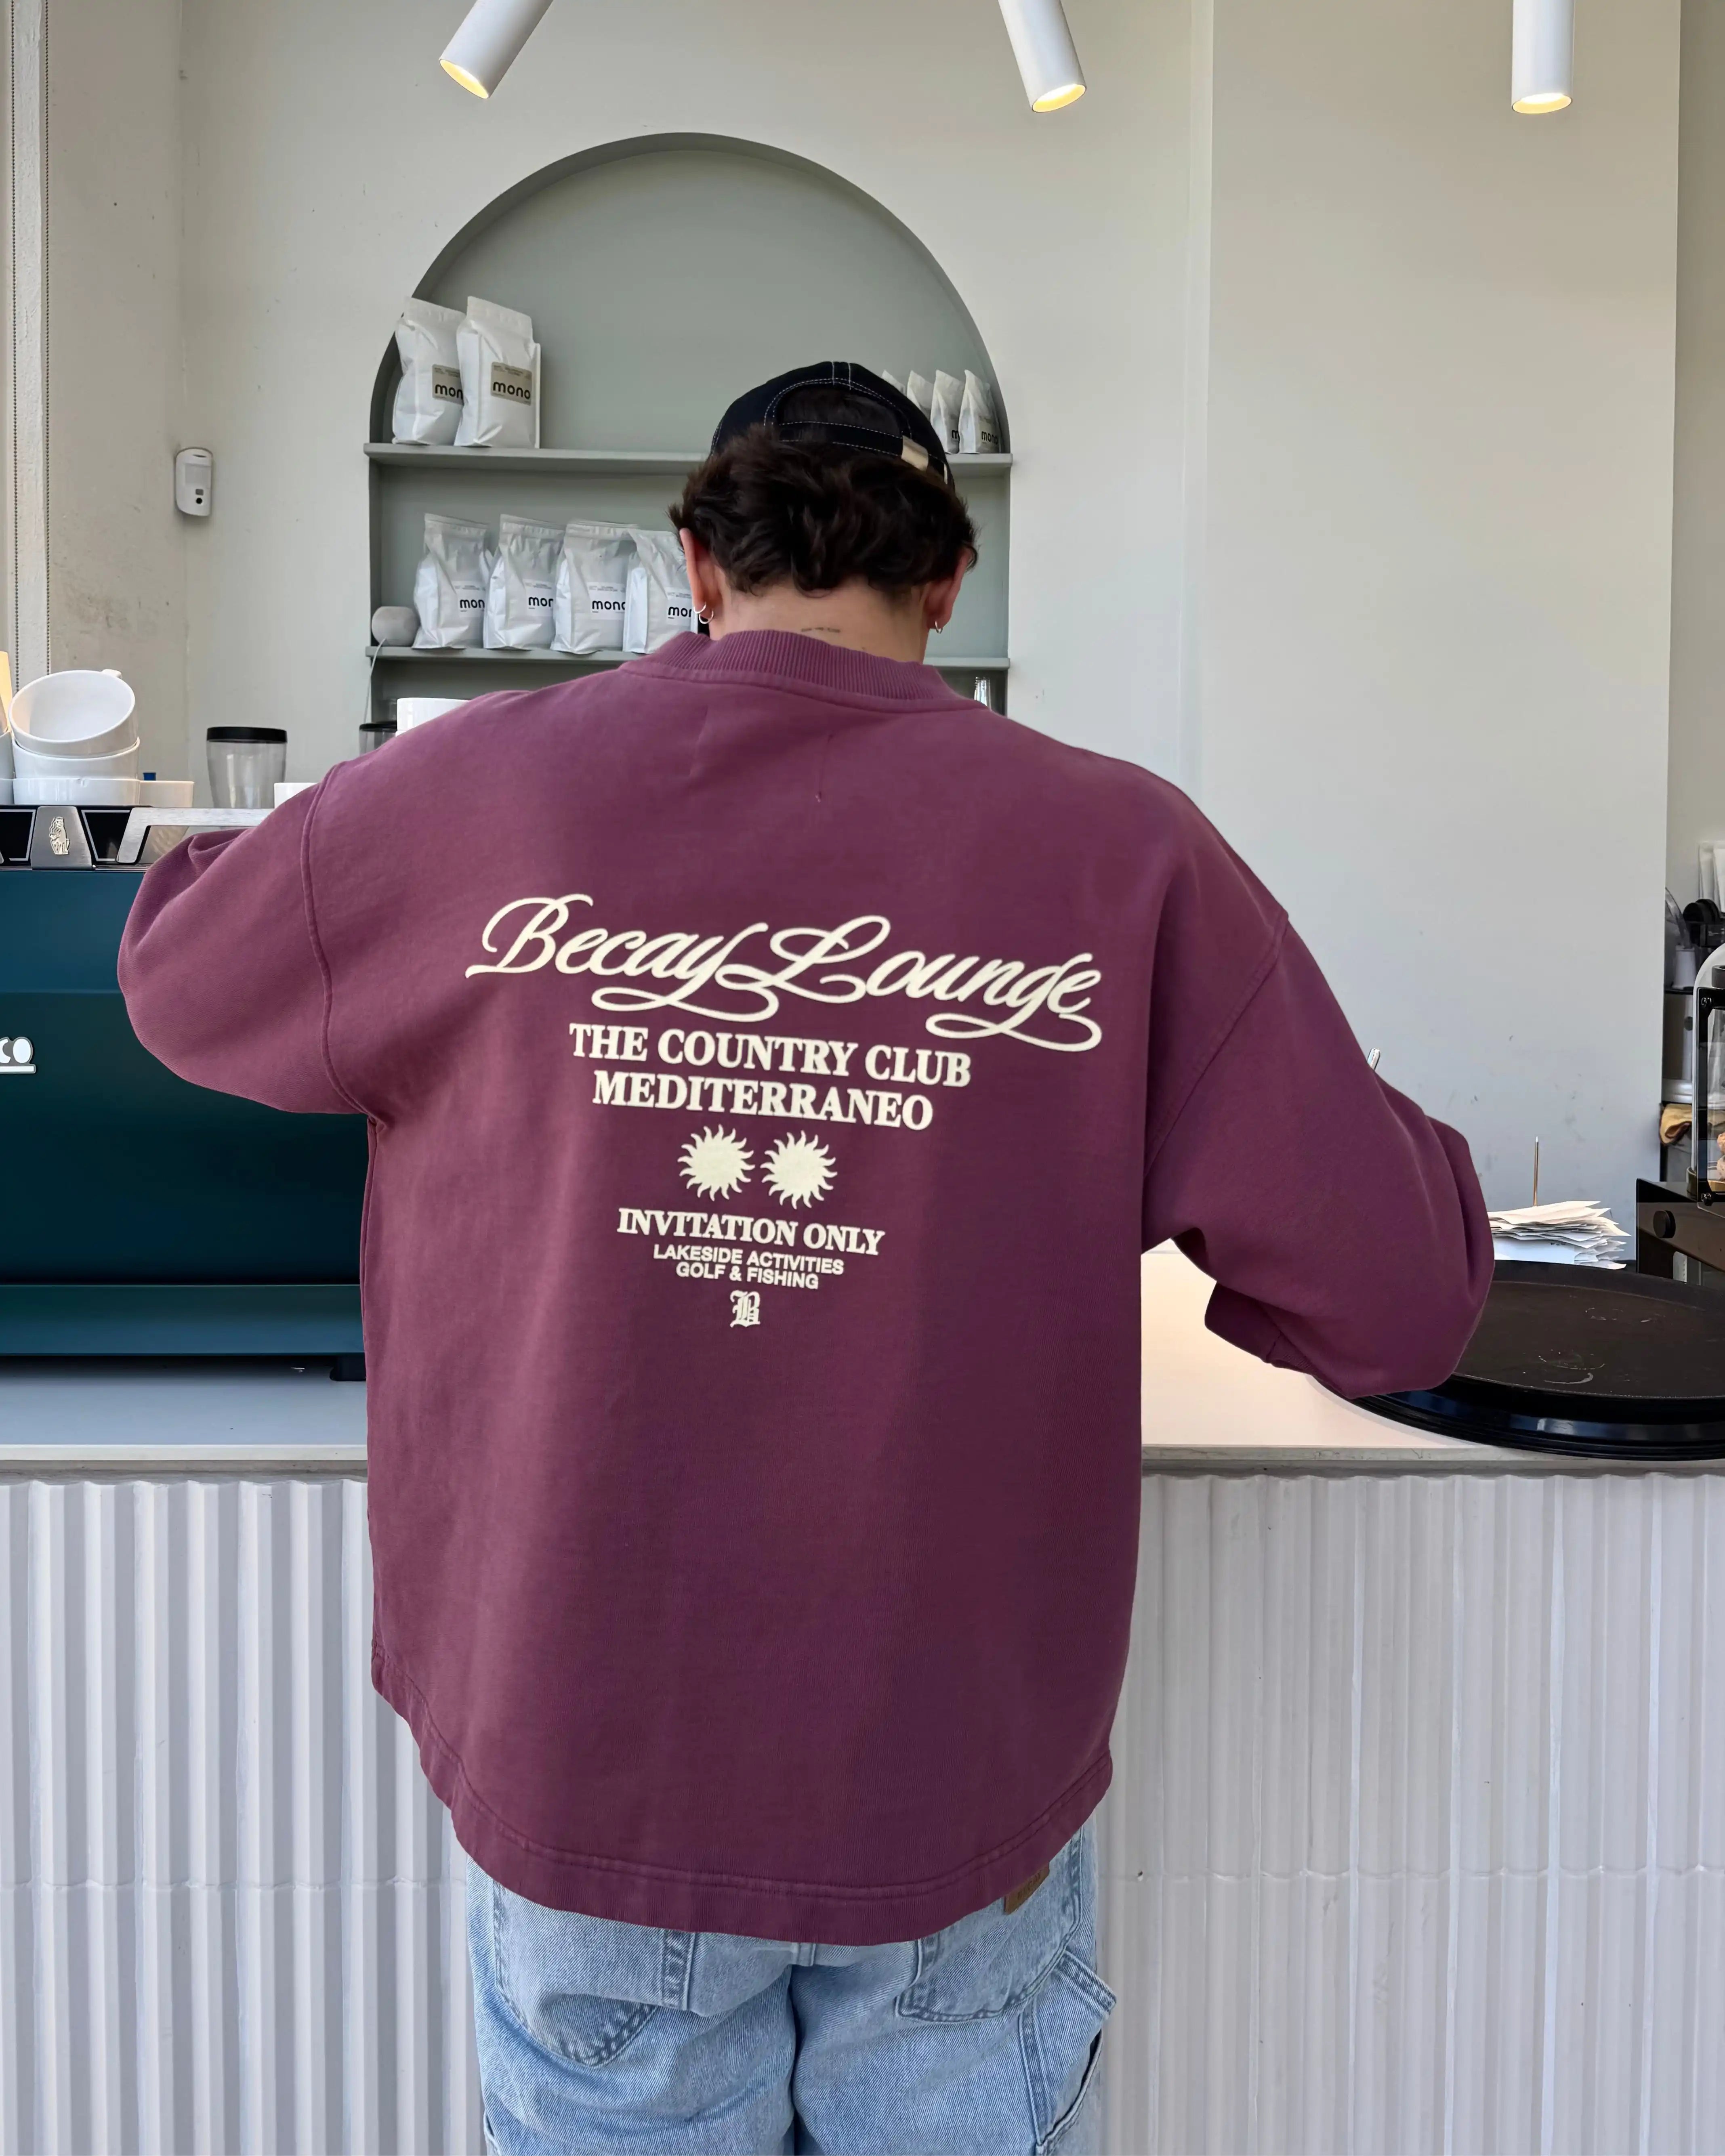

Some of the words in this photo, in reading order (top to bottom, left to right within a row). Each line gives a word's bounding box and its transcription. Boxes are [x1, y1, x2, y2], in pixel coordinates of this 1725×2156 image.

[435, 384, 463, 399] mon
[493, 382, 531, 399] mono
[460, 599, 485, 608] mon
[465, 894, 779, 1022] Becay
[714, 915, 1102, 1052] Lounge
[569, 1022, 649, 1062] THE
[658, 1029, 859, 1076] COUNTRY
[865, 1045, 971, 1087] CLUB
[592, 1070, 933, 1130] MEDITERRANEO
[617, 1208, 798, 1247] INVITATION
[803, 1223, 885, 1255] ONLY
[653, 1244, 743, 1265] LAKESIDE
[746, 1251, 844, 1275] ACTIVITIES
[676, 1262, 726, 1279] GOLF
[729, 1265, 742, 1281] &
[747, 1267, 819, 1289] FISHING
